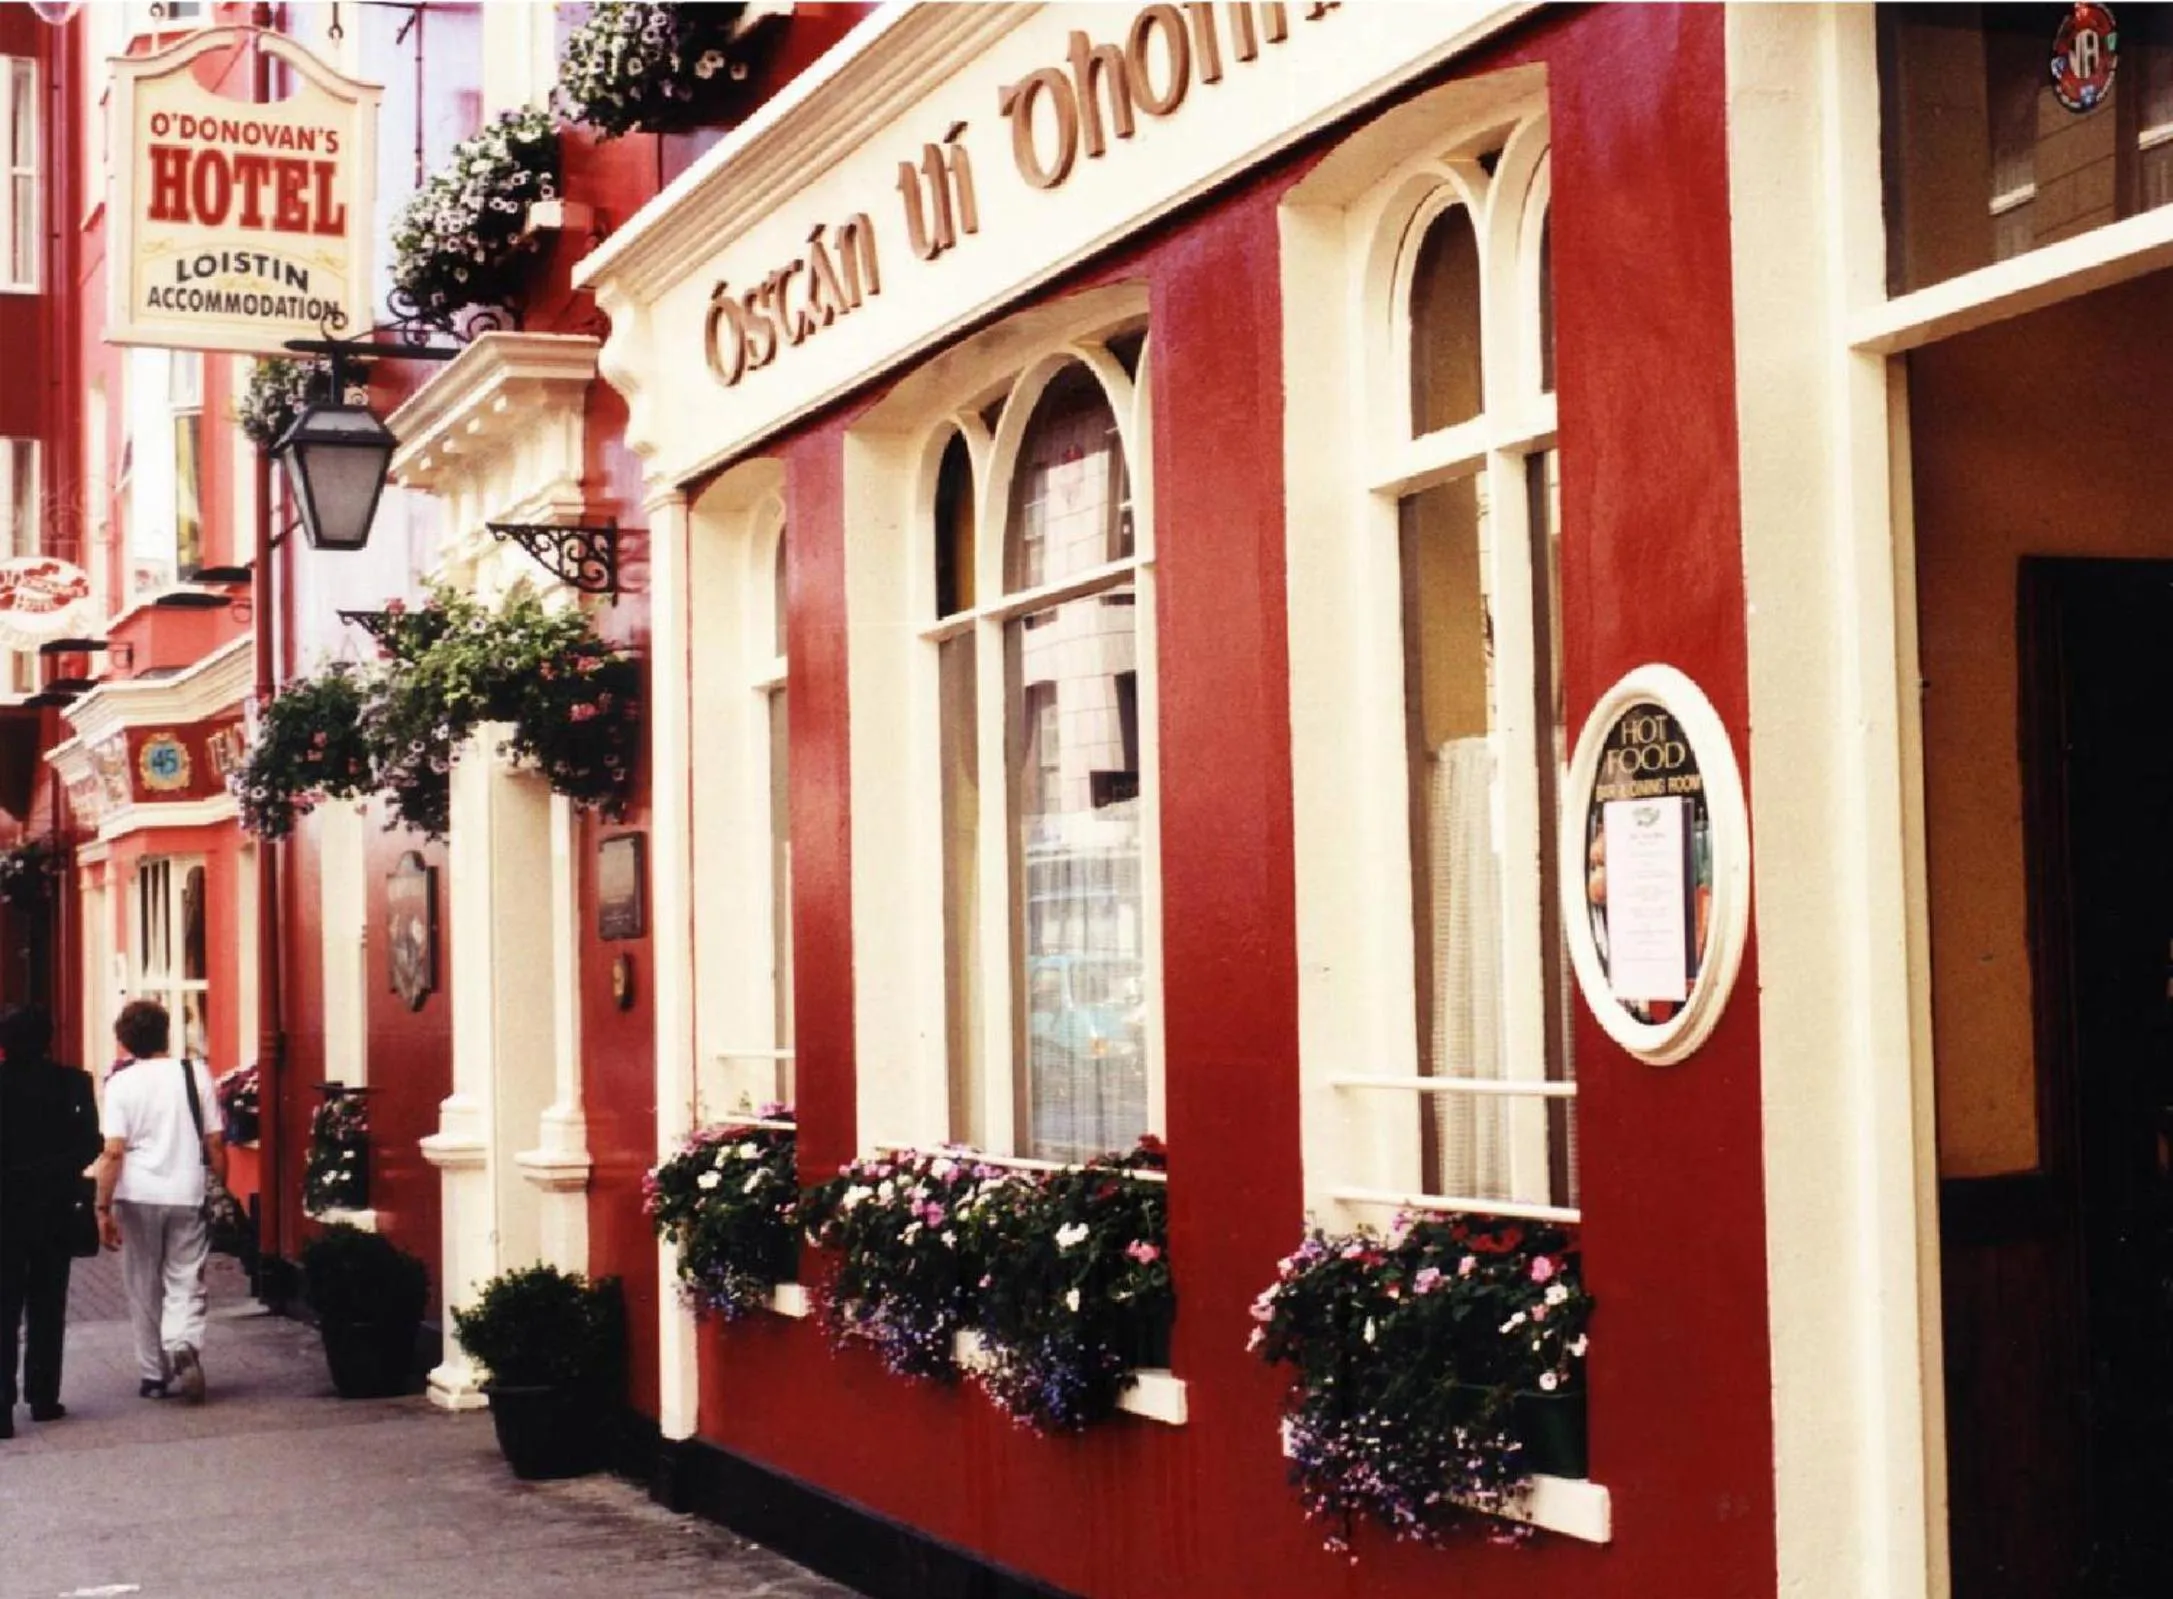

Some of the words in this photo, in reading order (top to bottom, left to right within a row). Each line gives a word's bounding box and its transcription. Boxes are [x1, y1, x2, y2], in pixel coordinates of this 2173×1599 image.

[150, 112, 340, 154] O'DONOVAN'S
[147, 143, 347, 237] HOTEL
[176, 251, 310, 293] LOISTIN
[147, 286, 341, 321] ACCOMMODATION
[1621, 714, 1668, 745] HOT
[1606, 741, 1686, 776] FOOD
[1668, 774, 1700, 794] ROOM
